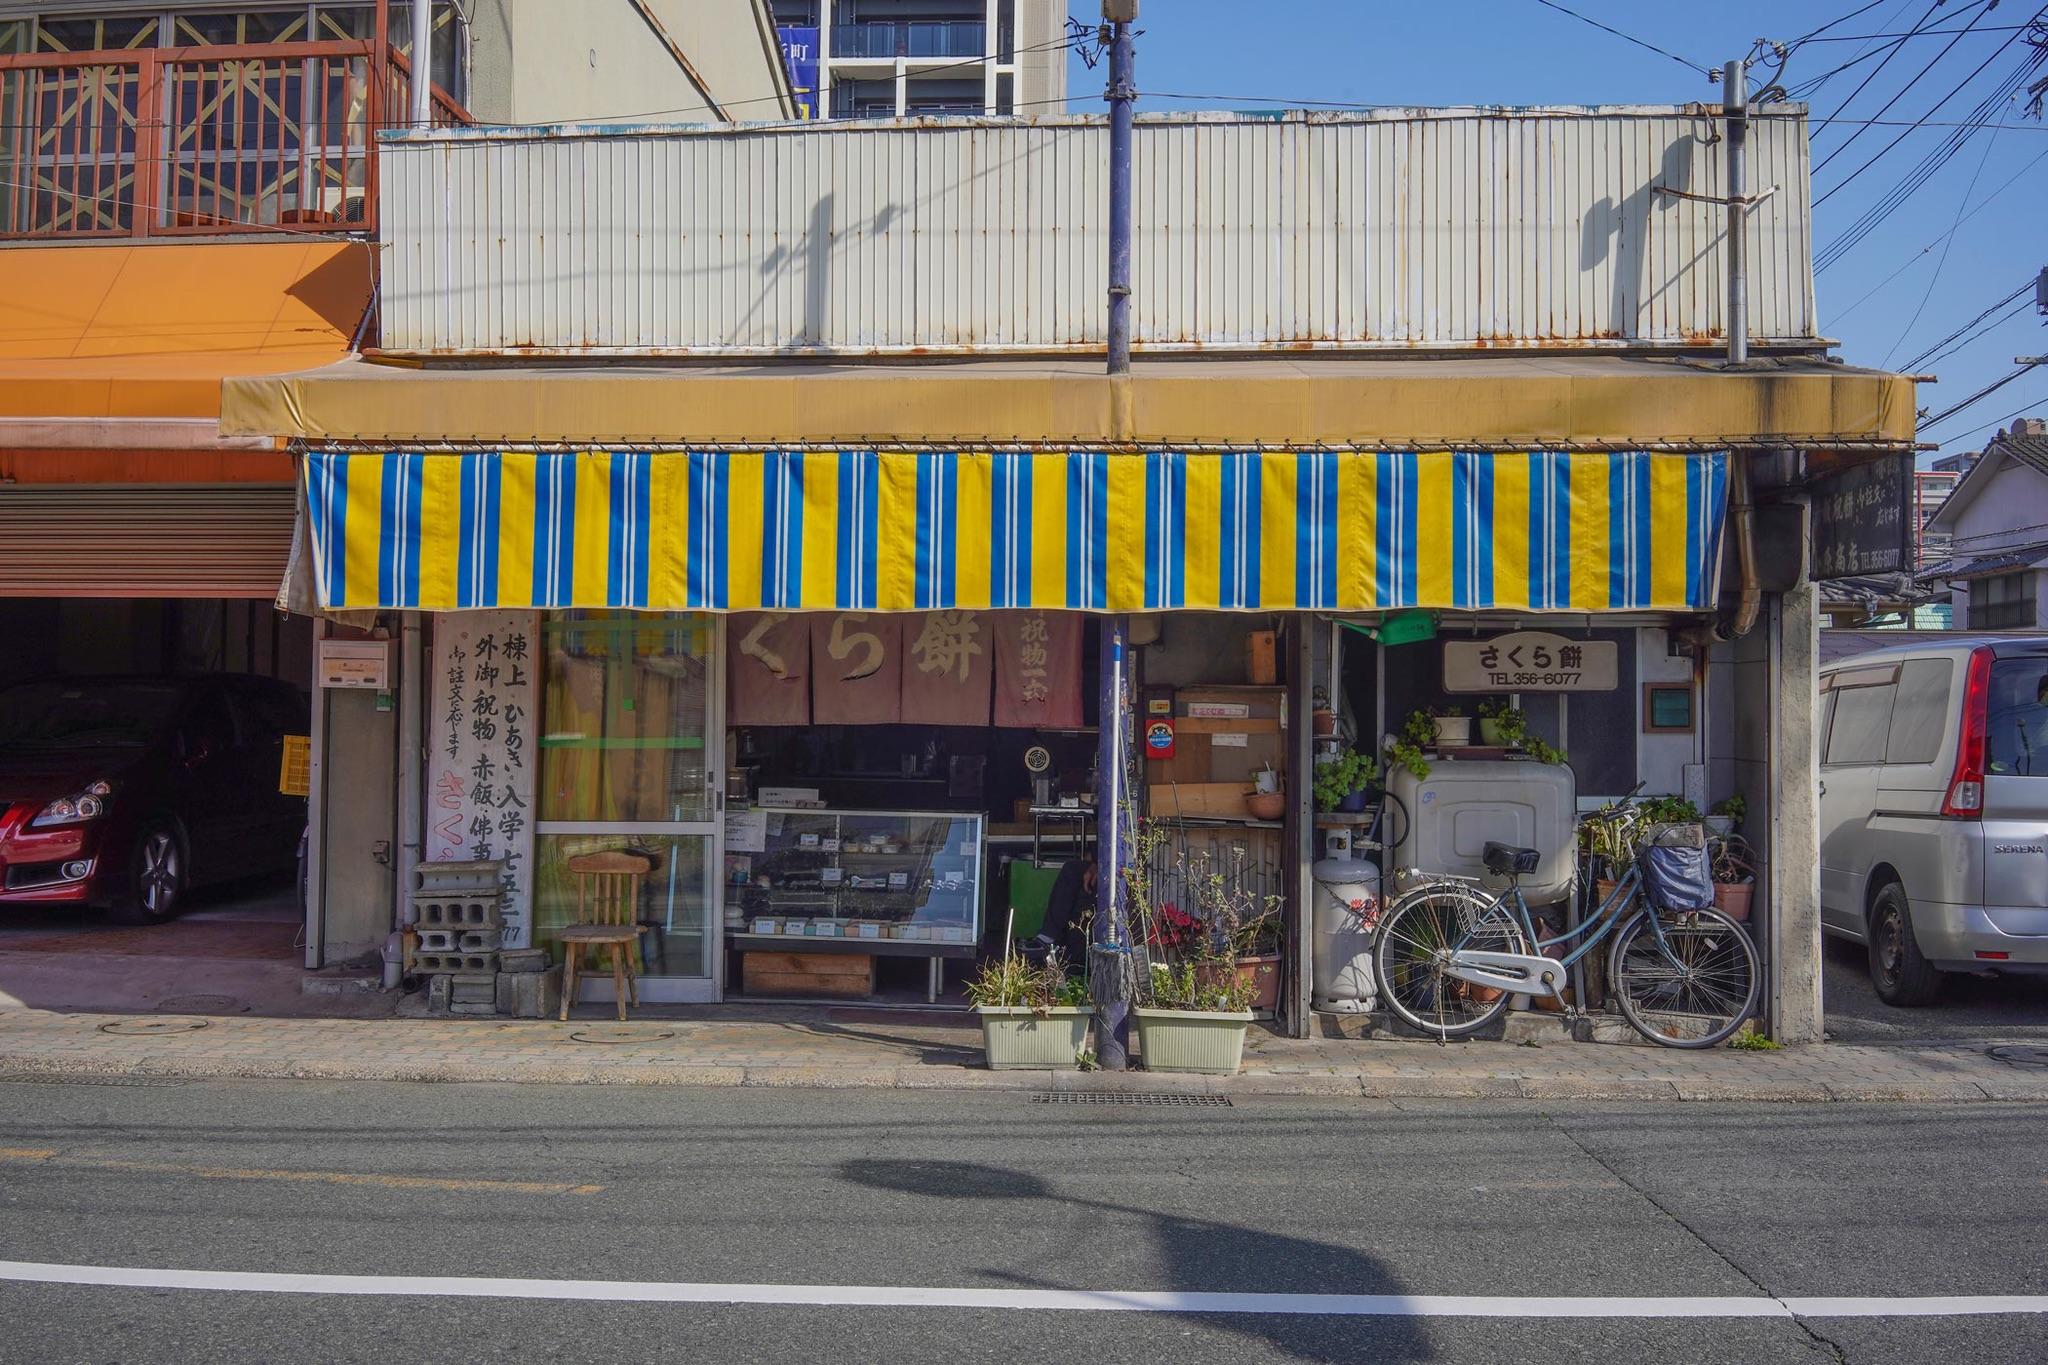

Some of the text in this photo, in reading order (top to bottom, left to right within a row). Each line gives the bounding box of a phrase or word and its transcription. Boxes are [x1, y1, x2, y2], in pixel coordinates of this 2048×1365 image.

[781, 43, 809, 62] 町
[1480, 645, 1583, 669] さくら餅
[1994, 844, 2044, 854] SERENA
